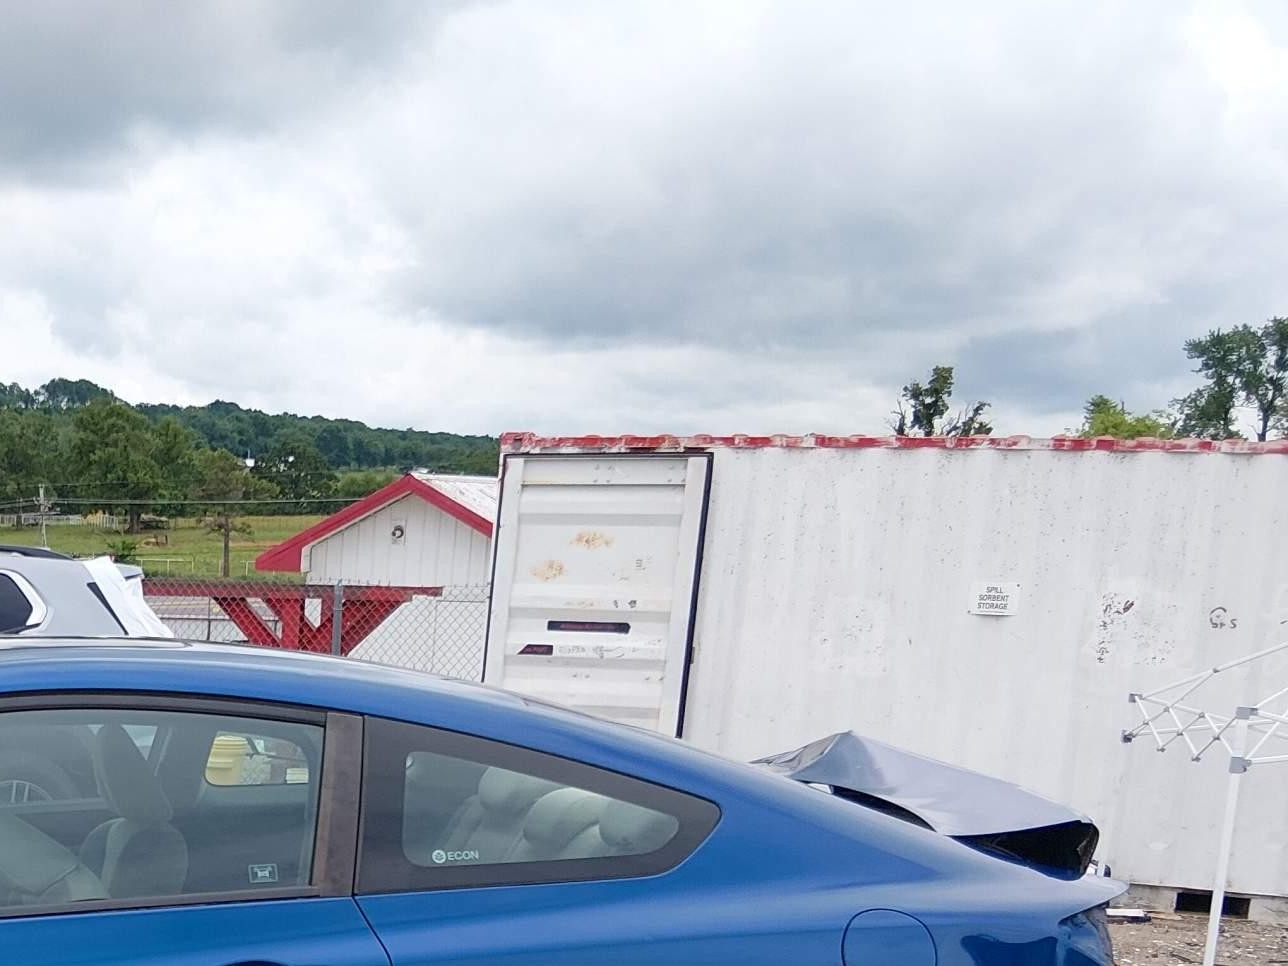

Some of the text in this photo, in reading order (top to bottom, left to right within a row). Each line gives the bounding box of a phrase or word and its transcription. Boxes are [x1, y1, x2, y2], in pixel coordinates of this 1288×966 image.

[978, 594, 1009, 602] SORBENT
[977, 602, 1008, 610] STORAGE
[447, 850, 479, 861] ECON
